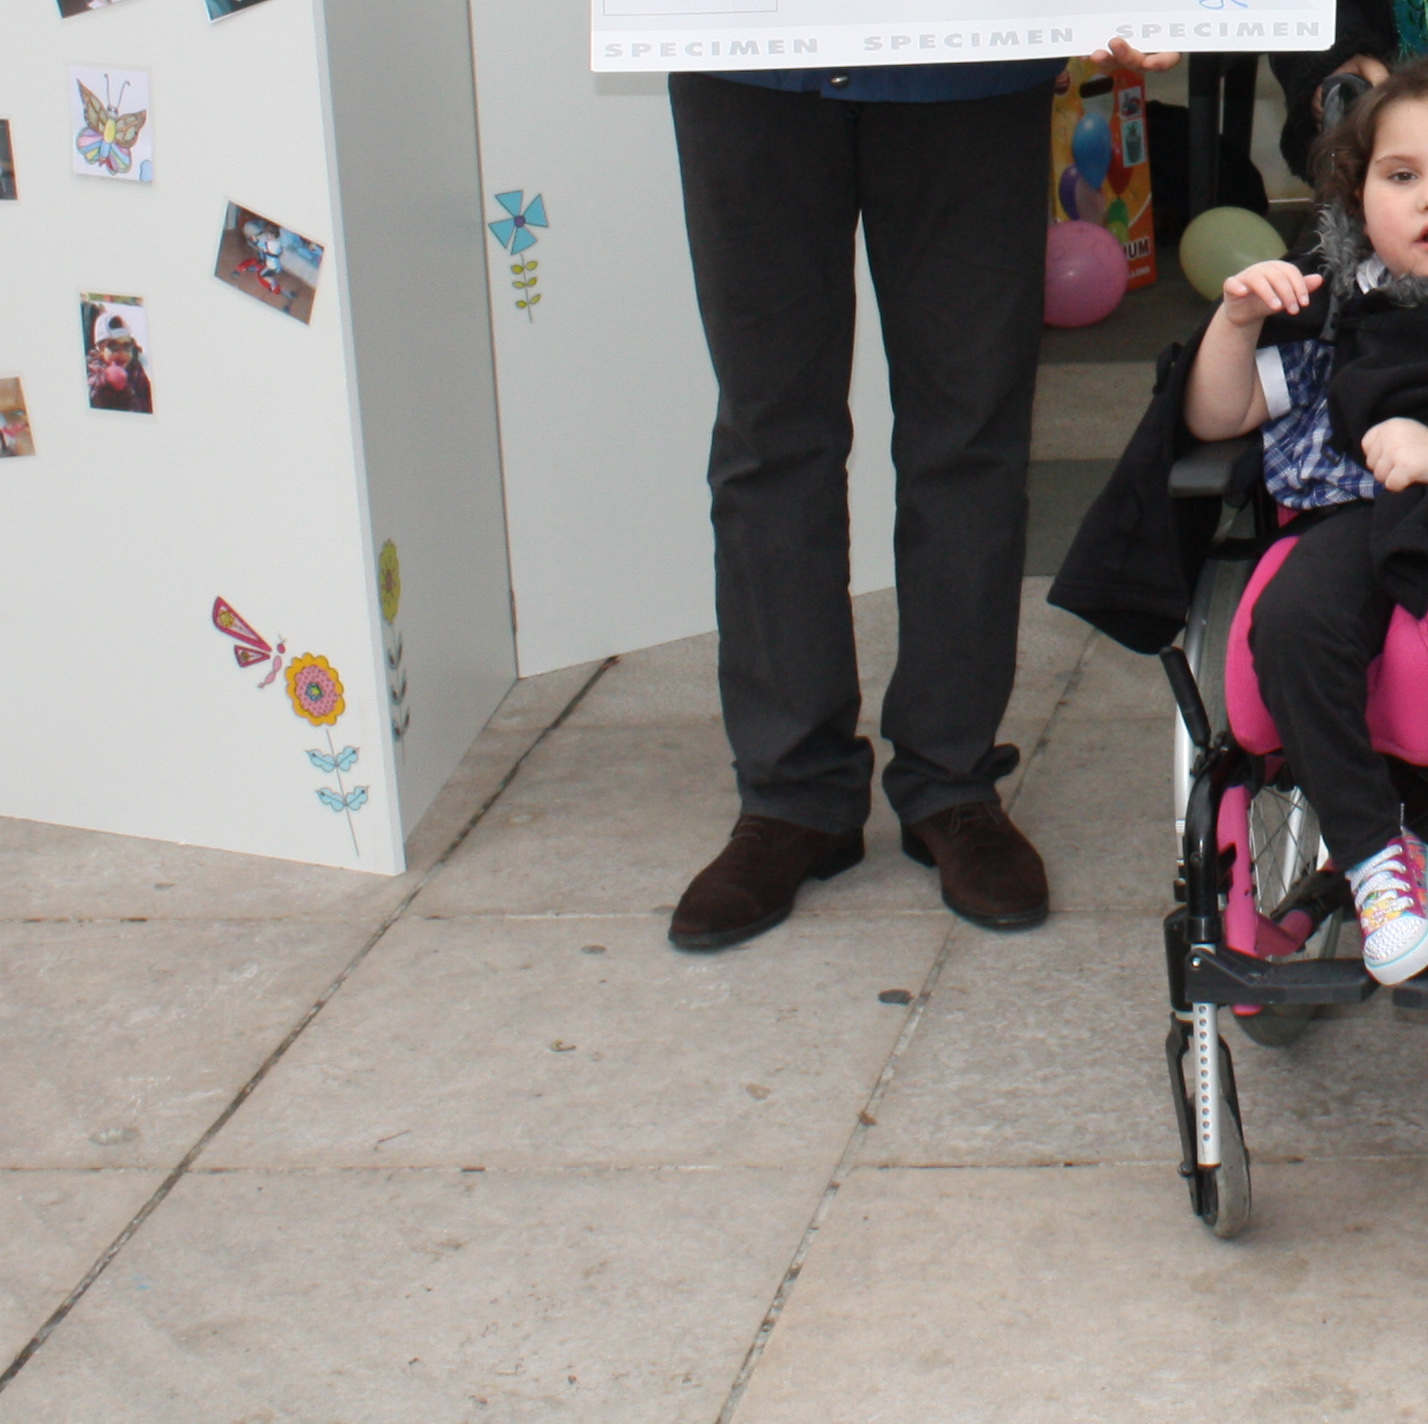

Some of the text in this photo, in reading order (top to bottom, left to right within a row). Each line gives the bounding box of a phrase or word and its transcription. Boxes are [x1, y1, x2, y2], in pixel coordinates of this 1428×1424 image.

[864, 27, 1074, 52] SPECIMEN
[1116, 21, 1320, 40] SPECIMEN
[604, 37, 819, 58] SPECIMEN
